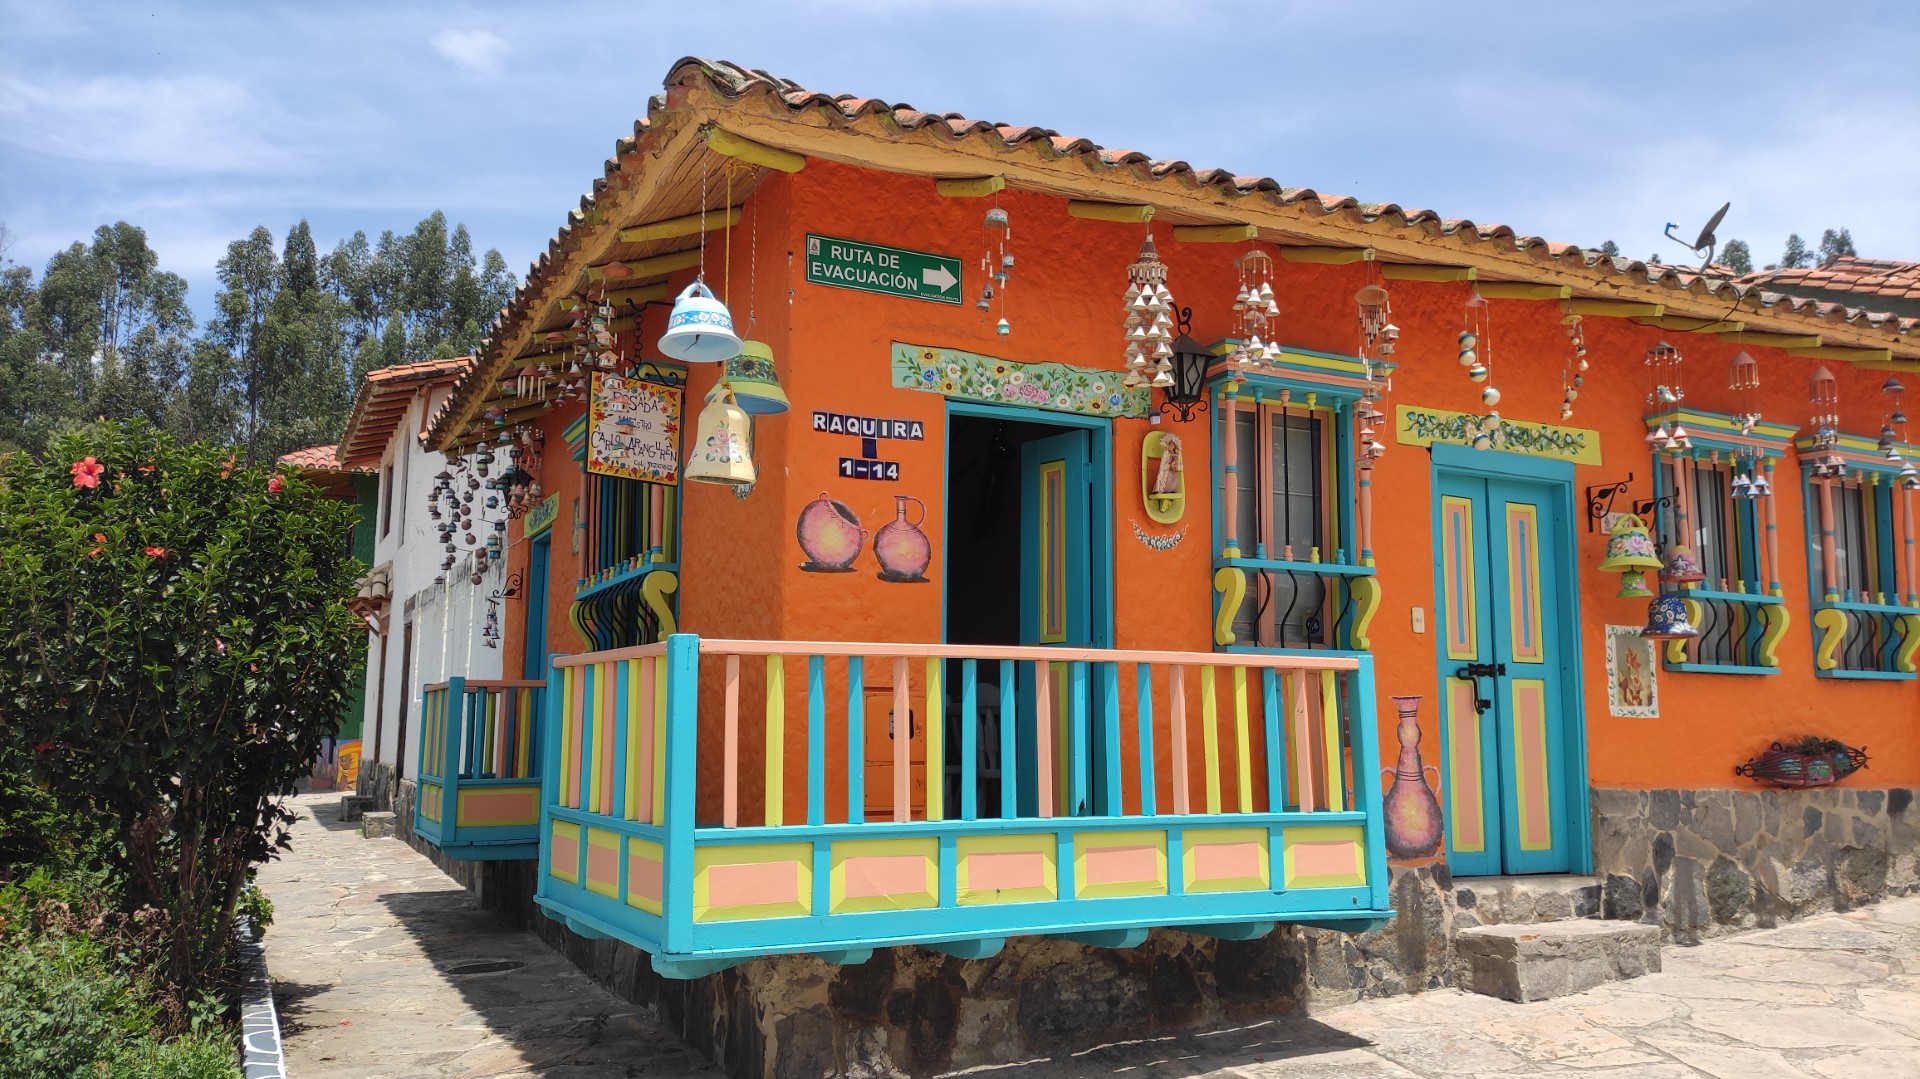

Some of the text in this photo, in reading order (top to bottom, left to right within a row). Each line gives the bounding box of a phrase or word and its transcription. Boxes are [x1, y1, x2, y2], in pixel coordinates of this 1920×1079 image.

[831, 245, 900, 269] RUTA DE
[812, 261, 918, 290] EVACUACIÓN
[613, 391, 659, 413] PSADA
[813, 414, 923, 438] RAQUIRA
[629, 437, 677, 461] ARANGUREN
[841, 460, 898, 479] 1-14
